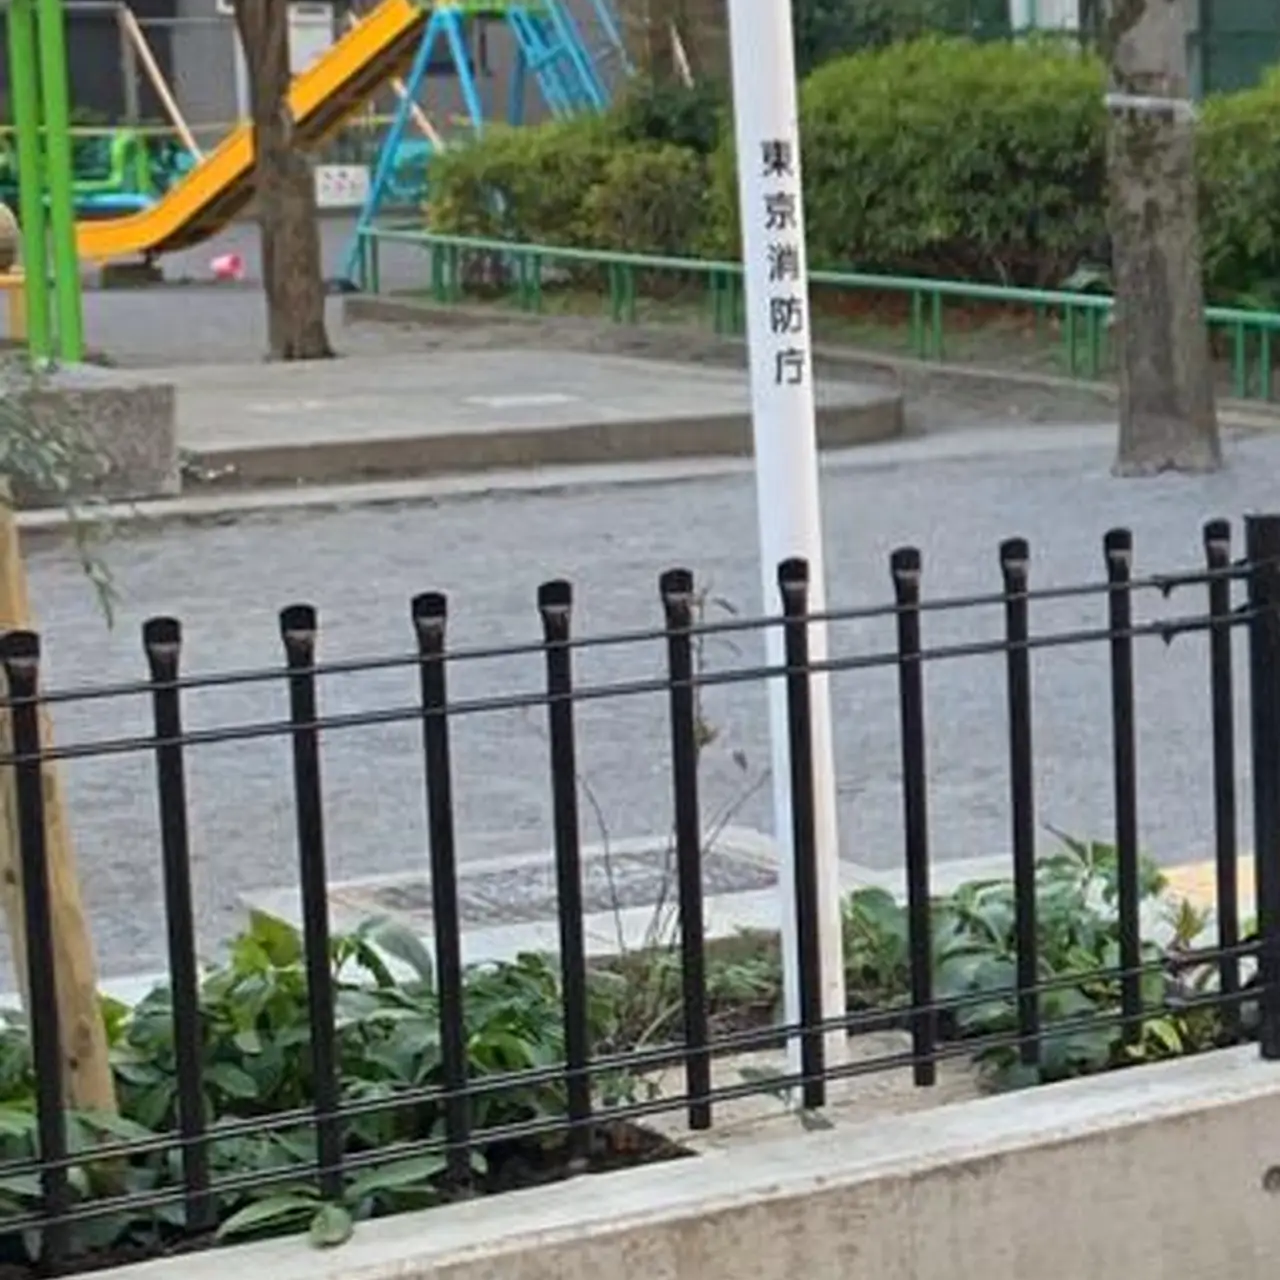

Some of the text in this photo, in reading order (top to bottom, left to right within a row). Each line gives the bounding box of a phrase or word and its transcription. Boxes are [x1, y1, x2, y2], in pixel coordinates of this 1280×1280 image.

[761, 139, 806, 385] 東京消防庁
